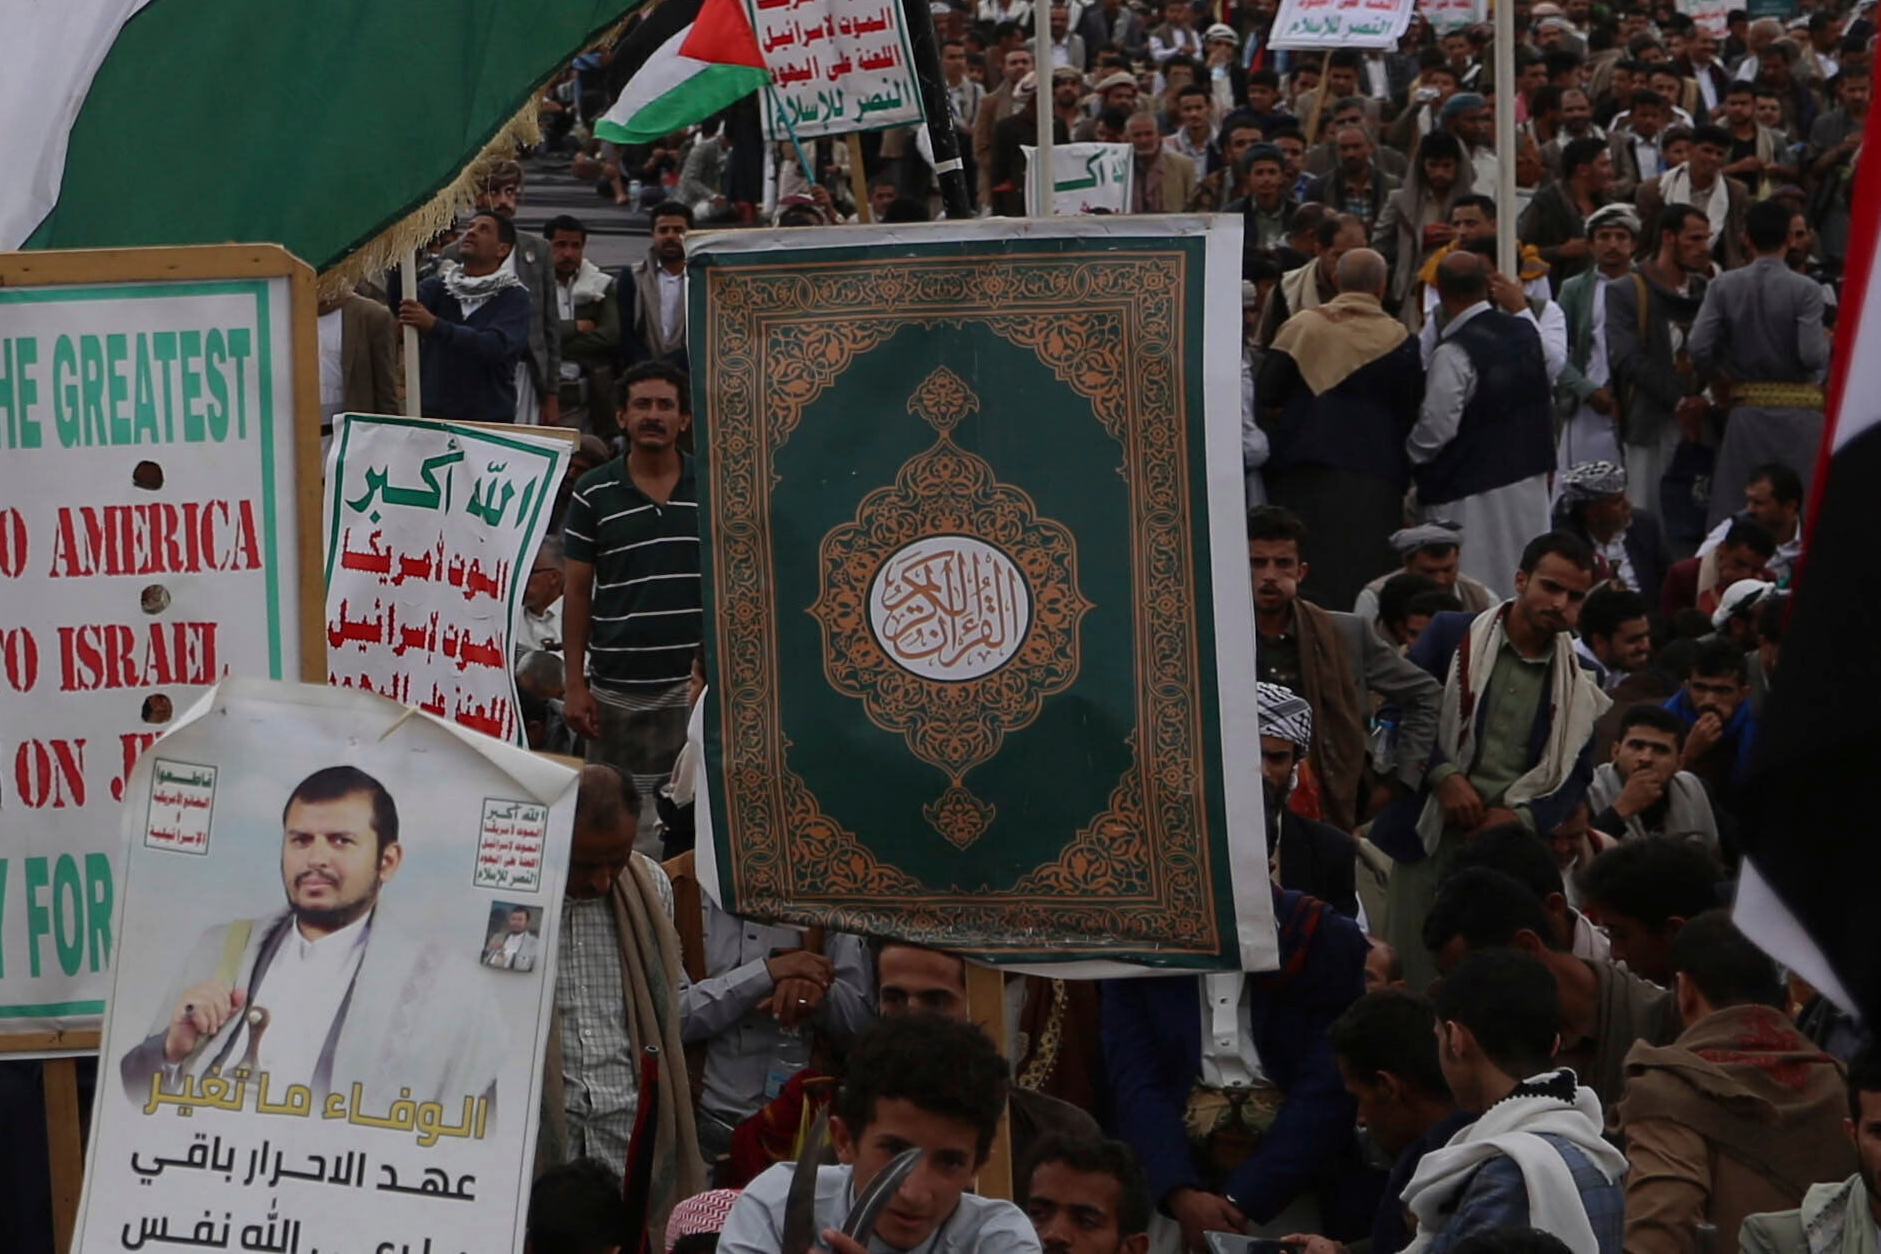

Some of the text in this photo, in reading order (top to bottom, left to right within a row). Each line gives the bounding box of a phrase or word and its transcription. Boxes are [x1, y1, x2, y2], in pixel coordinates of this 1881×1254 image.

[763, 6, 893, 54] الموت لإسرائيل
[858, 45, 902, 72] اللعنة
[826, 51, 852, 81] على
[853, 77, 911, 123] النصر
[52, 327, 251, 447] GREATEST
[345, 438, 538, 529] الله أكبر
[49, 500, 263, 578] AMERICA
[341, 526, 445, 586] لأمريكا
[57, 621, 229, 692] ISRAEL
[327, 597, 439, 664] لإسرائيل
[15, 738, 87, 809] ON
[25, 853, 115, 979] FOR
[143, 1065, 488, 1146] الوفاء ما تغير
[129, 1133, 476, 1202] عهد الاحرار باقي
[120, 1209, 231, 1251] نفس
